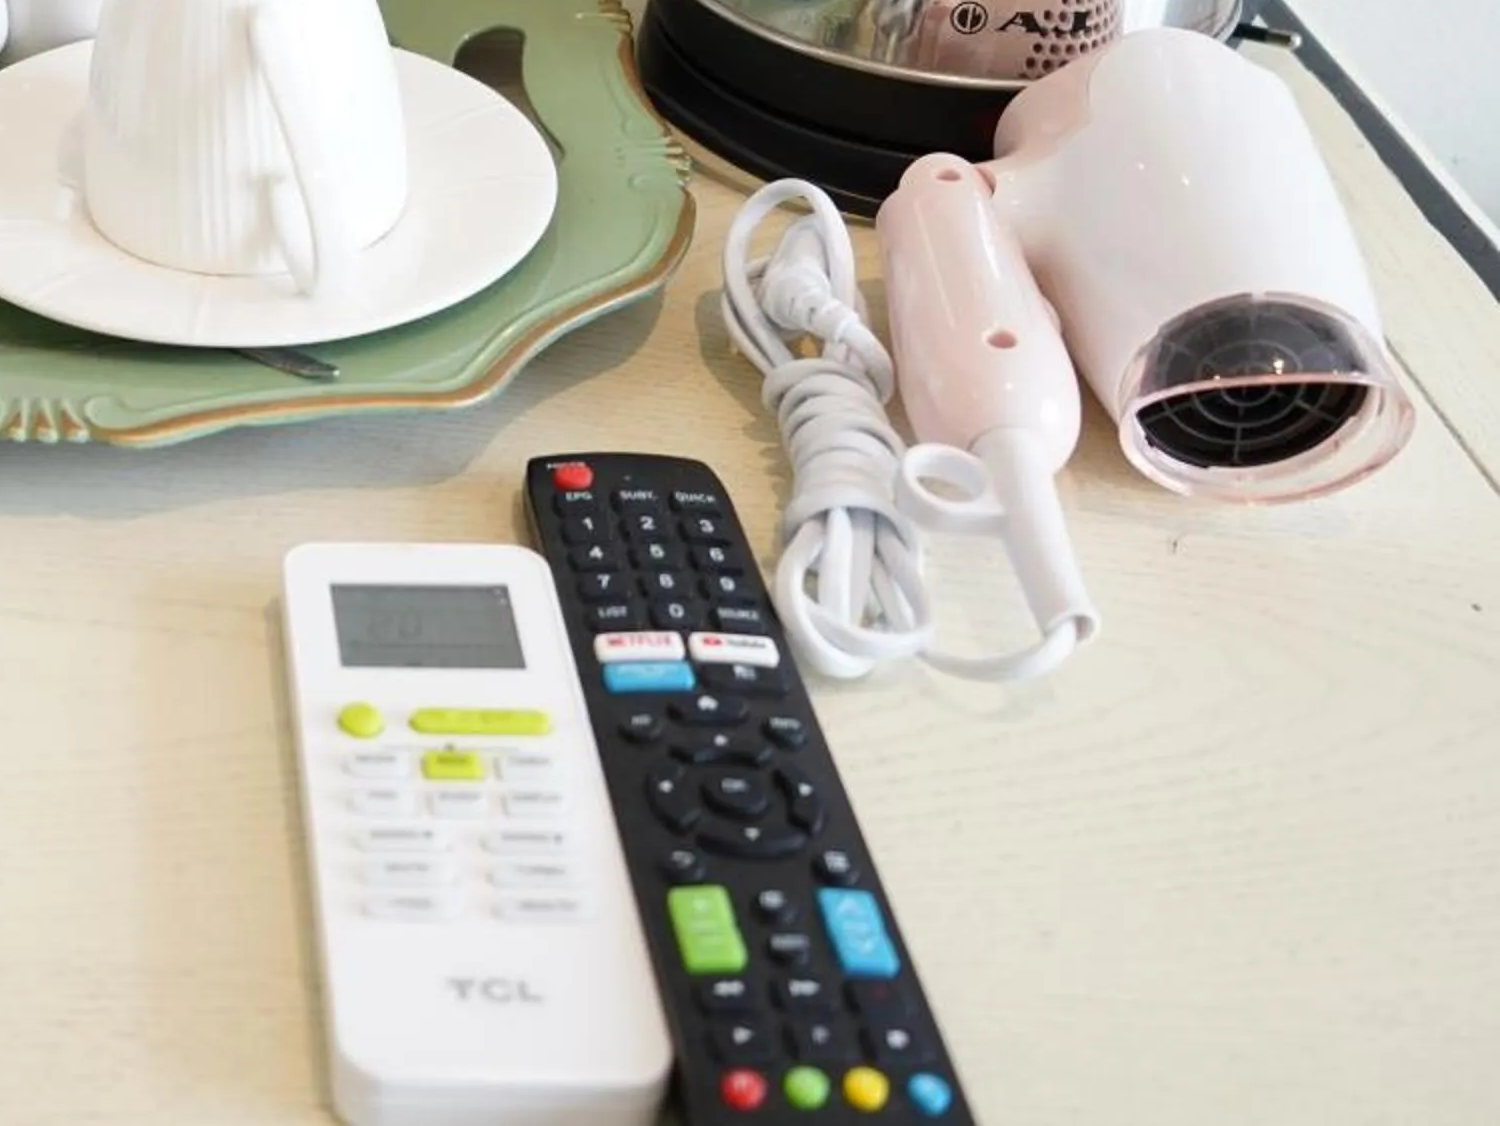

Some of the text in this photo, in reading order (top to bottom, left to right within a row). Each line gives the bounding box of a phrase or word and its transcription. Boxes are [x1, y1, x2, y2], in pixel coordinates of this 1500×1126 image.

[565, 490, 593, 502] EPG
[582, 516, 594, 531] 1
[640, 515, 656, 531] 2
[699, 518, 715, 534] 3
[588, 545, 604, 560] 4
[649, 543, 665, 560] 5
[709, 547, 725, 563] 6
[597, 573, 611, 589] 7
[659, 573, 675, 589] 8
[719, 576, 735, 592] 9
[598, 605, 628, 618] LIST
[668, 602, 684, 619] 0
[717, 607, 760, 620] SOURCE
[447, 976, 545, 1003] TCL
